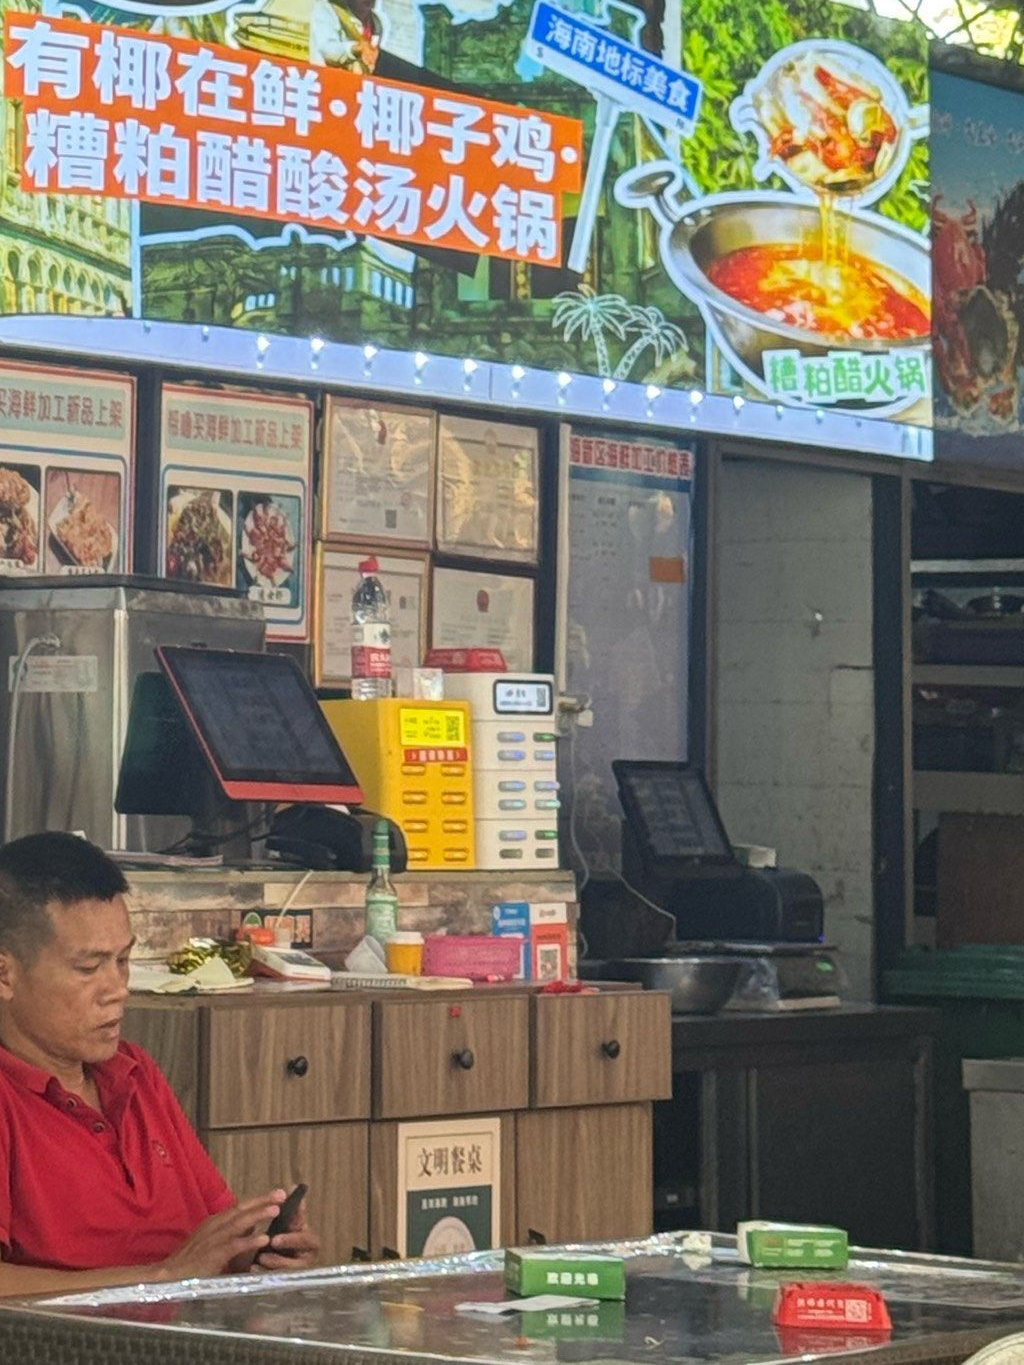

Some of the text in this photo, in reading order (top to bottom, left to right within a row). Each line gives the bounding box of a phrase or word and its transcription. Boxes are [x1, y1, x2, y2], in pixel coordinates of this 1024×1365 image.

[544, 14, 693, 112] 海南地标美食
[24, 108, 558, 260] 糟粕醋酸汤火锅
[769, 355, 926, 397] 糟粕醋火锅
[417, 1144, 482, 1177] 文明餐桌
